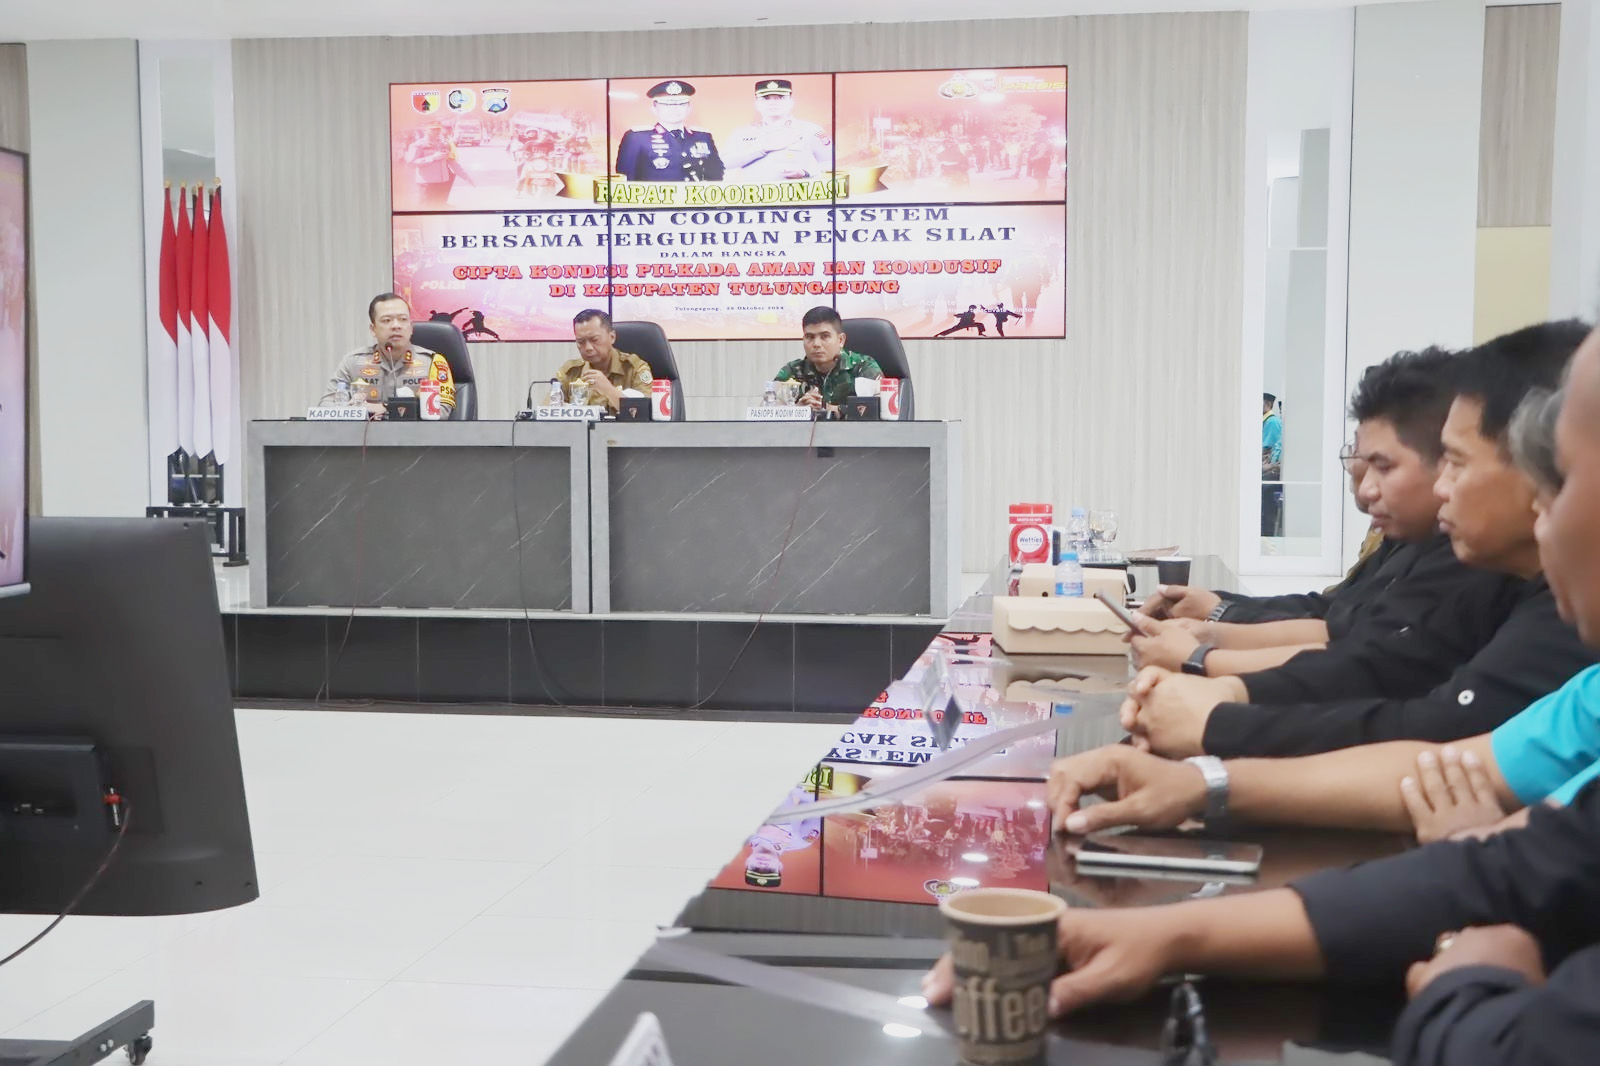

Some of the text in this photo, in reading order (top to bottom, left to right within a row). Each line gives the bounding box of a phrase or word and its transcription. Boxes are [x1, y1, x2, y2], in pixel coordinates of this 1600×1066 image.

[596, 178, 847, 205] RAPAT KOORDINASI
[502, 207, 950, 228] KEGIATAN COOLING SYSTEM
[441, 226, 1017, 249] BERSAMA PERGURUAN PENCAK SILAT
[721, 249, 787, 257] RANGKA
[452, 265, 523, 281] CIPTA
[529, 263, 629, 280] KONDISI
[636, 262, 740, 279] PILKADA
[747, 261, 815, 276] AMAN
[872, 259, 1002, 275] KONDUSIF
[549, 279, 900, 298] DI KABUPATEN TULUNGAGUNG
[308, 409, 363, 419] KAPOLRES
[539, 408, 595, 418] SEKDA
[750, 408, 774, 419] PASIOPS
[775, 408, 795, 418] KODIM
